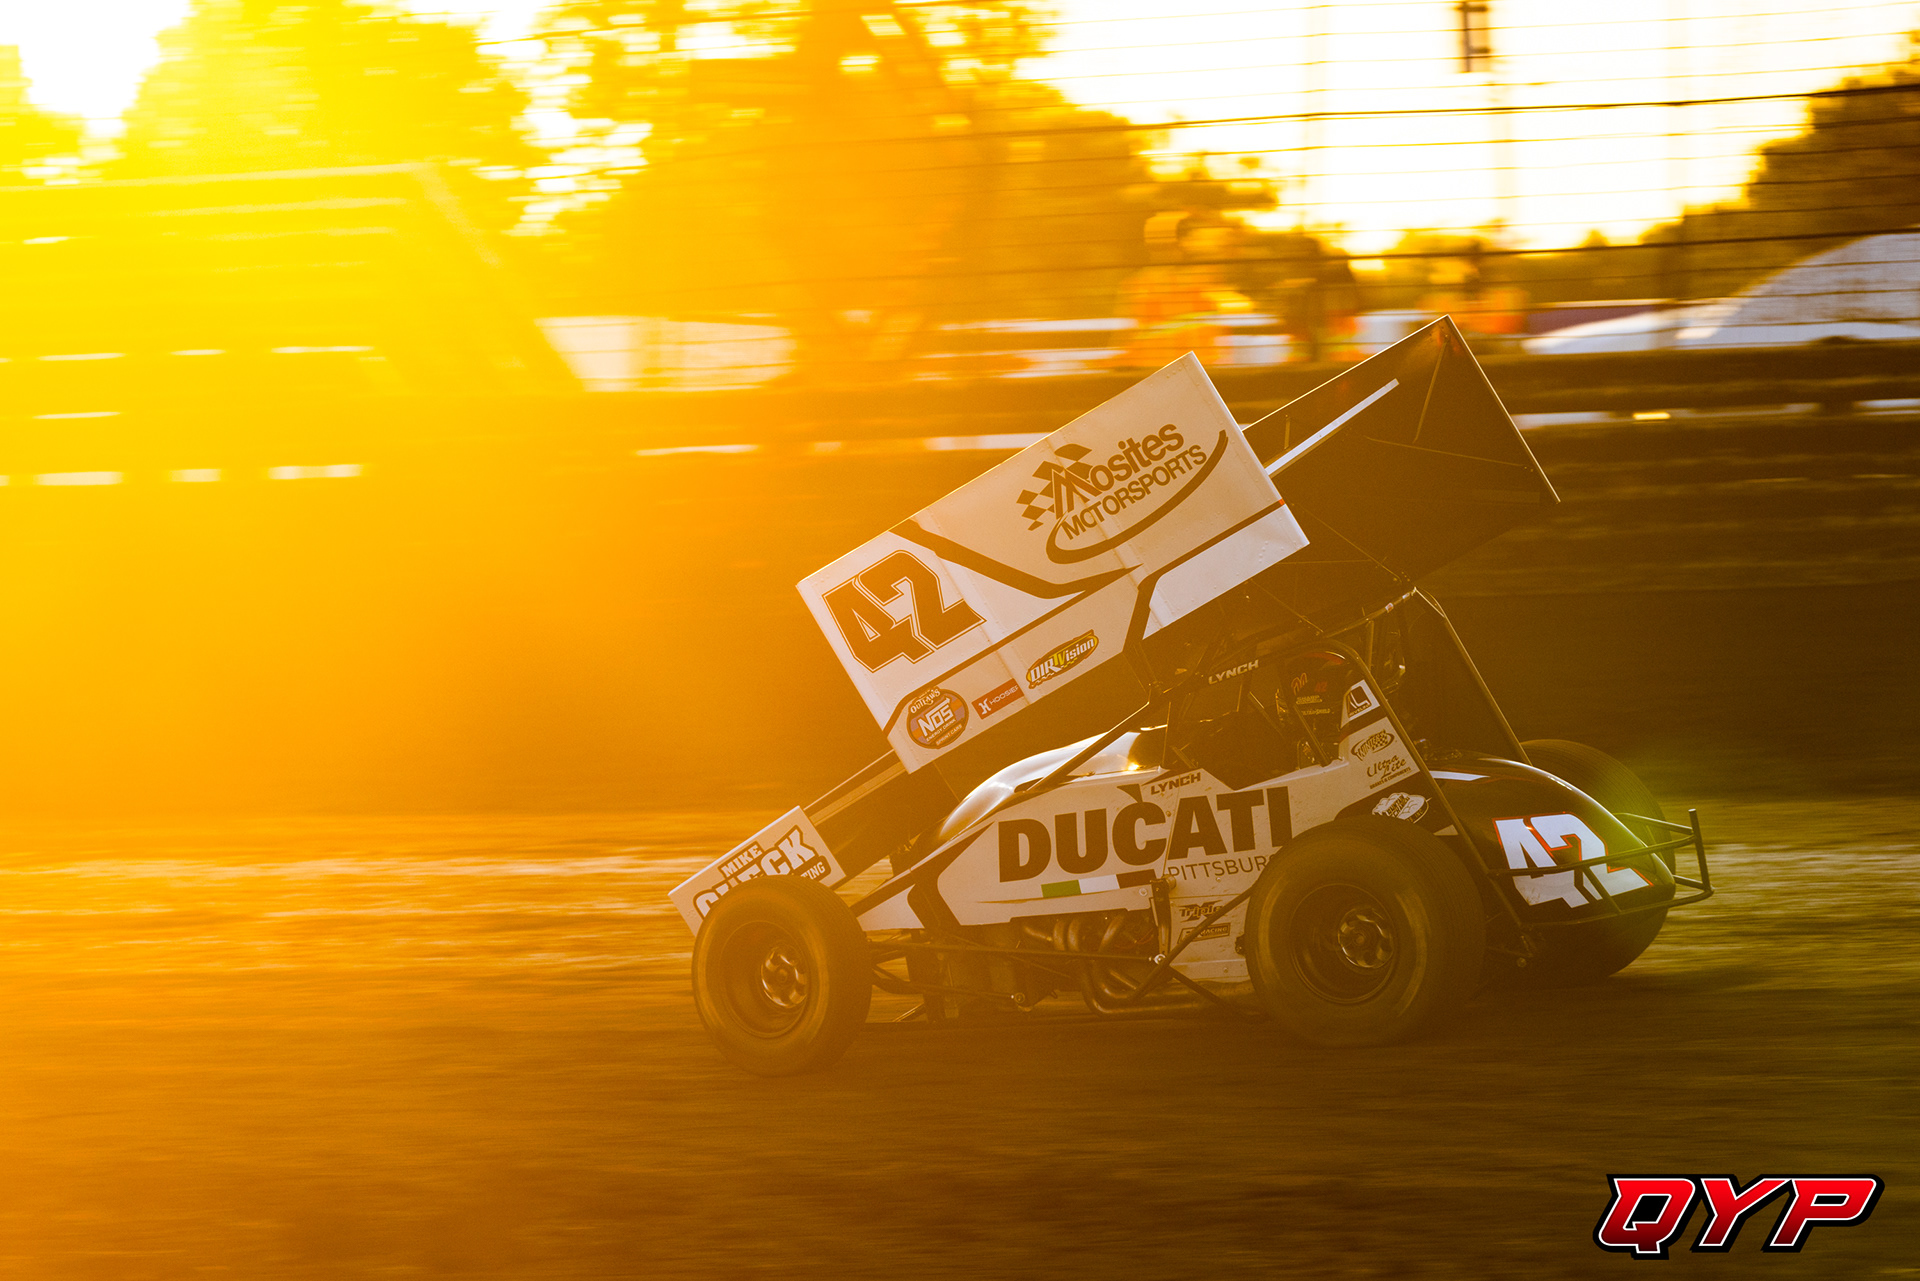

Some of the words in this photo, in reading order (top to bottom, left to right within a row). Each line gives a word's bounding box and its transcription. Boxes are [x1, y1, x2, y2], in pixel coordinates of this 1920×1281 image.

[1052, 424, 1184, 519] Mosites
[1061, 445, 1207, 540] MOTORSPORTS
[822, 550, 987, 673] 42
[1208, 660, 1258, 684] LYNCH
[918, 697, 954, 737] NOS
[1151, 772, 1201, 795] LYNCH
[1367, 755, 1399, 777] Ultra
[1381, 759, 1406, 779] Lite
[998, 786, 1293, 883] DUCATI
[721, 844, 762, 878] MIKE
[1492, 811, 1654, 908] 42
